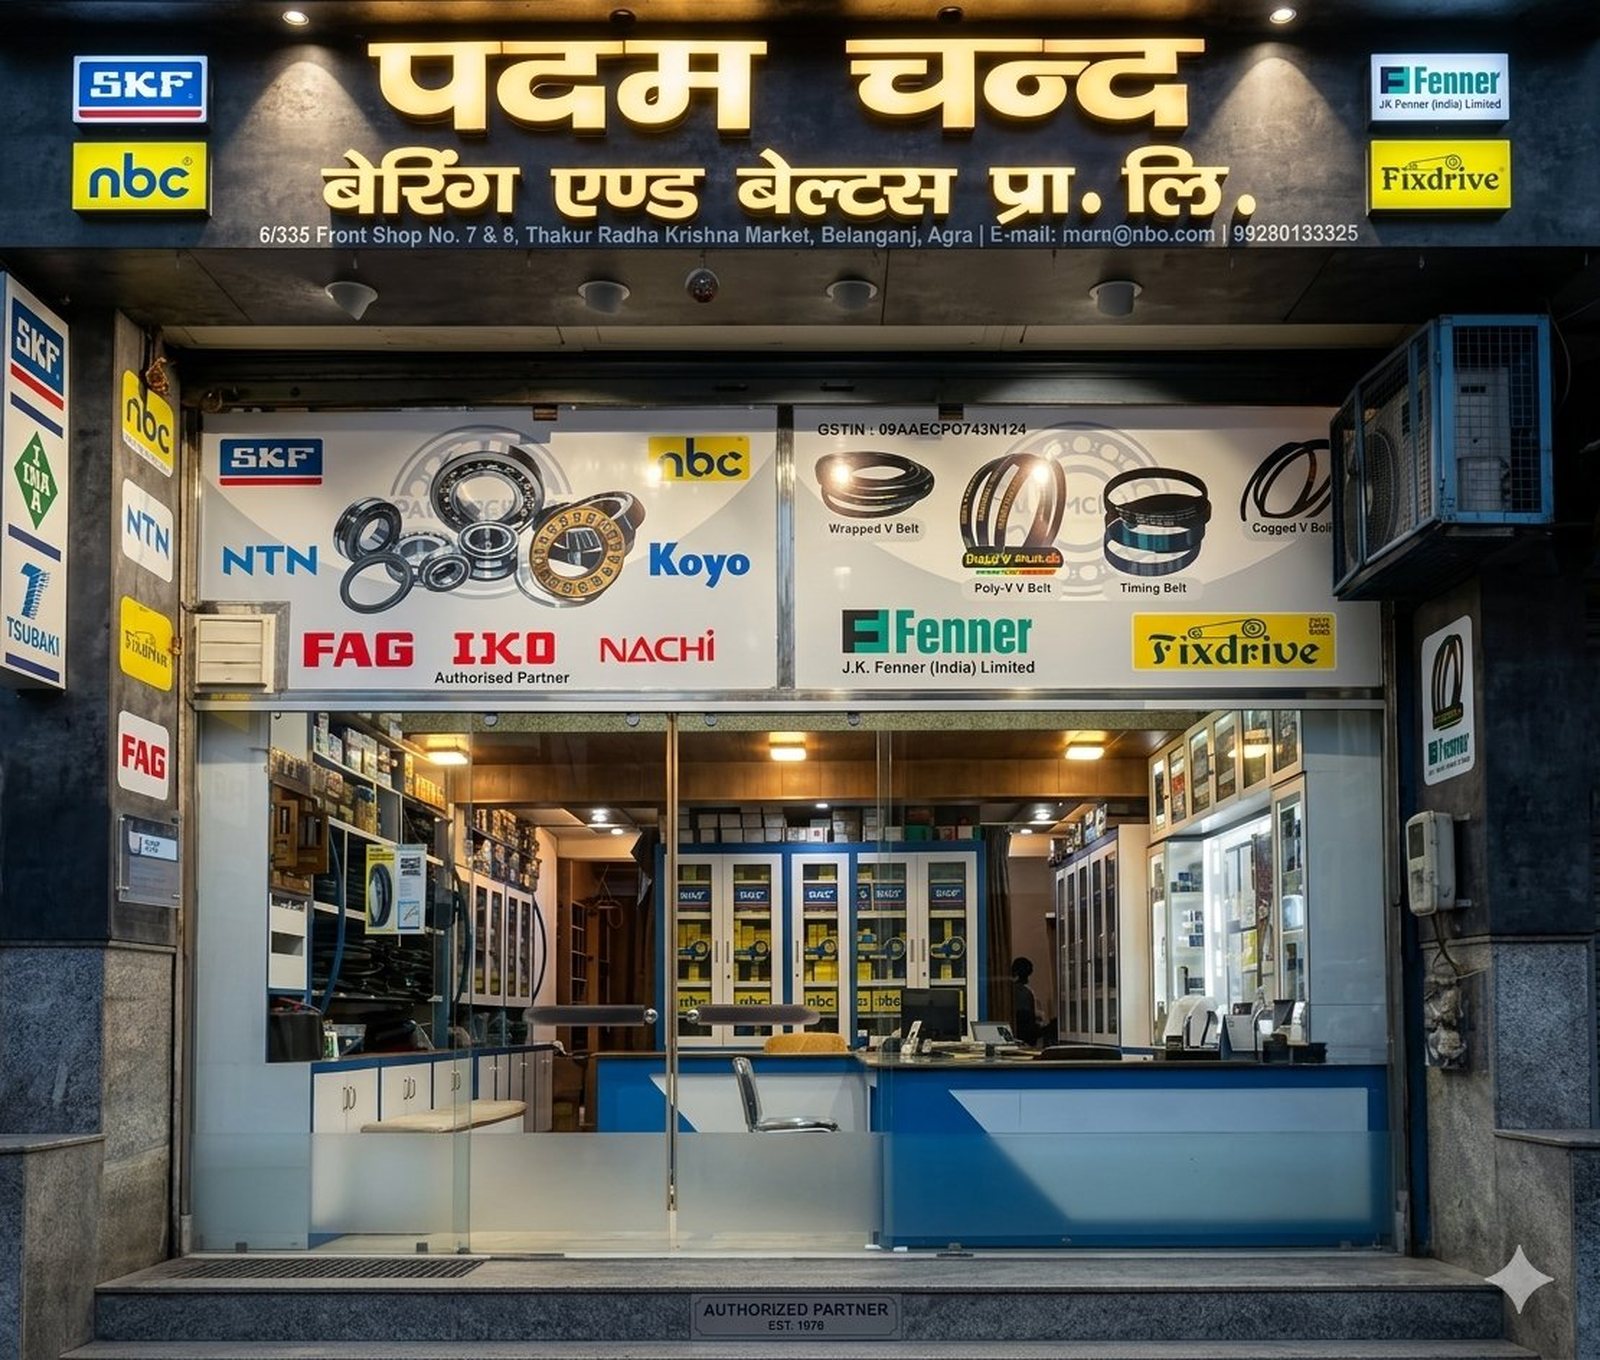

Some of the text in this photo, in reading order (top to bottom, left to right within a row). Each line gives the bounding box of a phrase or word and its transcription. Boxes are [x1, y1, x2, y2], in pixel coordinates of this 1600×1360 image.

[90, 71, 193, 98] SKF
[368, 38, 1205, 131] पदम चन्द
[1414, 66, 1500, 94] Fenner
[1465, 99, 1501, 109] Limited
[89, 153, 190, 198] nbc
[321, 146, 520, 216] बेरिंग
[550, 168, 706, 220] एण्ड
[736, 148, 957, 218] बेल्टस
[1381, 166, 1499, 191] Fixdrive
[259, 226, 310, 244] 6/335
[316, 226, 367, 244] Front
[372, 226, 422, 248] Shop
[429, 226, 460, 244] No.
[466, 226, 476, 243] 7
[483, 226, 498, 244] &
[503, 226, 519, 246] 8,
[525, 226, 593, 244] Thakur
[599, 226, 659, 244] Radha
[665, 226, 739, 244] Krishna
[746, 226, 815, 246] Market,
[822, 225, 922, 248] Belanganj,
[928, 226, 973, 248] Agra
[990, 225, 1056, 244] E-mail:
[1233, 224, 1359, 242] 99280133325
[16, 317, 60, 374] SKF
[817, 423, 865, 436] GSTIN
[231, 447, 315, 468] SKF
[658, 437, 742, 478] nbc
[127, 503, 169, 561] NTN
[828, 523, 919, 536] Wrapped V Belt
[1299, 523, 1308, 533] V
[223, 545, 317, 576] NTN
[649, 542, 750, 588] Koyo
[975, 582, 1013, 596] Poly-V
[1015, 582, 1024, 593] V
[1120, 582, 1187, 596] Timing Belt
[7, 615, 60, 657] TSUBAKI
[896, 609, 1032, 654] Fenner
[303, 632, 414, 668] FAG
[453, 632, 555, 665] IKO
[1148, 633, 1320, 665] Fixdrive
[435, 671, 570, 685] Authorised Partner
[842, 660, 1035, 676] J.K. Fenner (India) Limited
[122, 732, 165, 780] FAG
[703, 1303, 889, 1317] AUTHORIZED PARTNER
[768, 1320, 794, 1331] EST.
